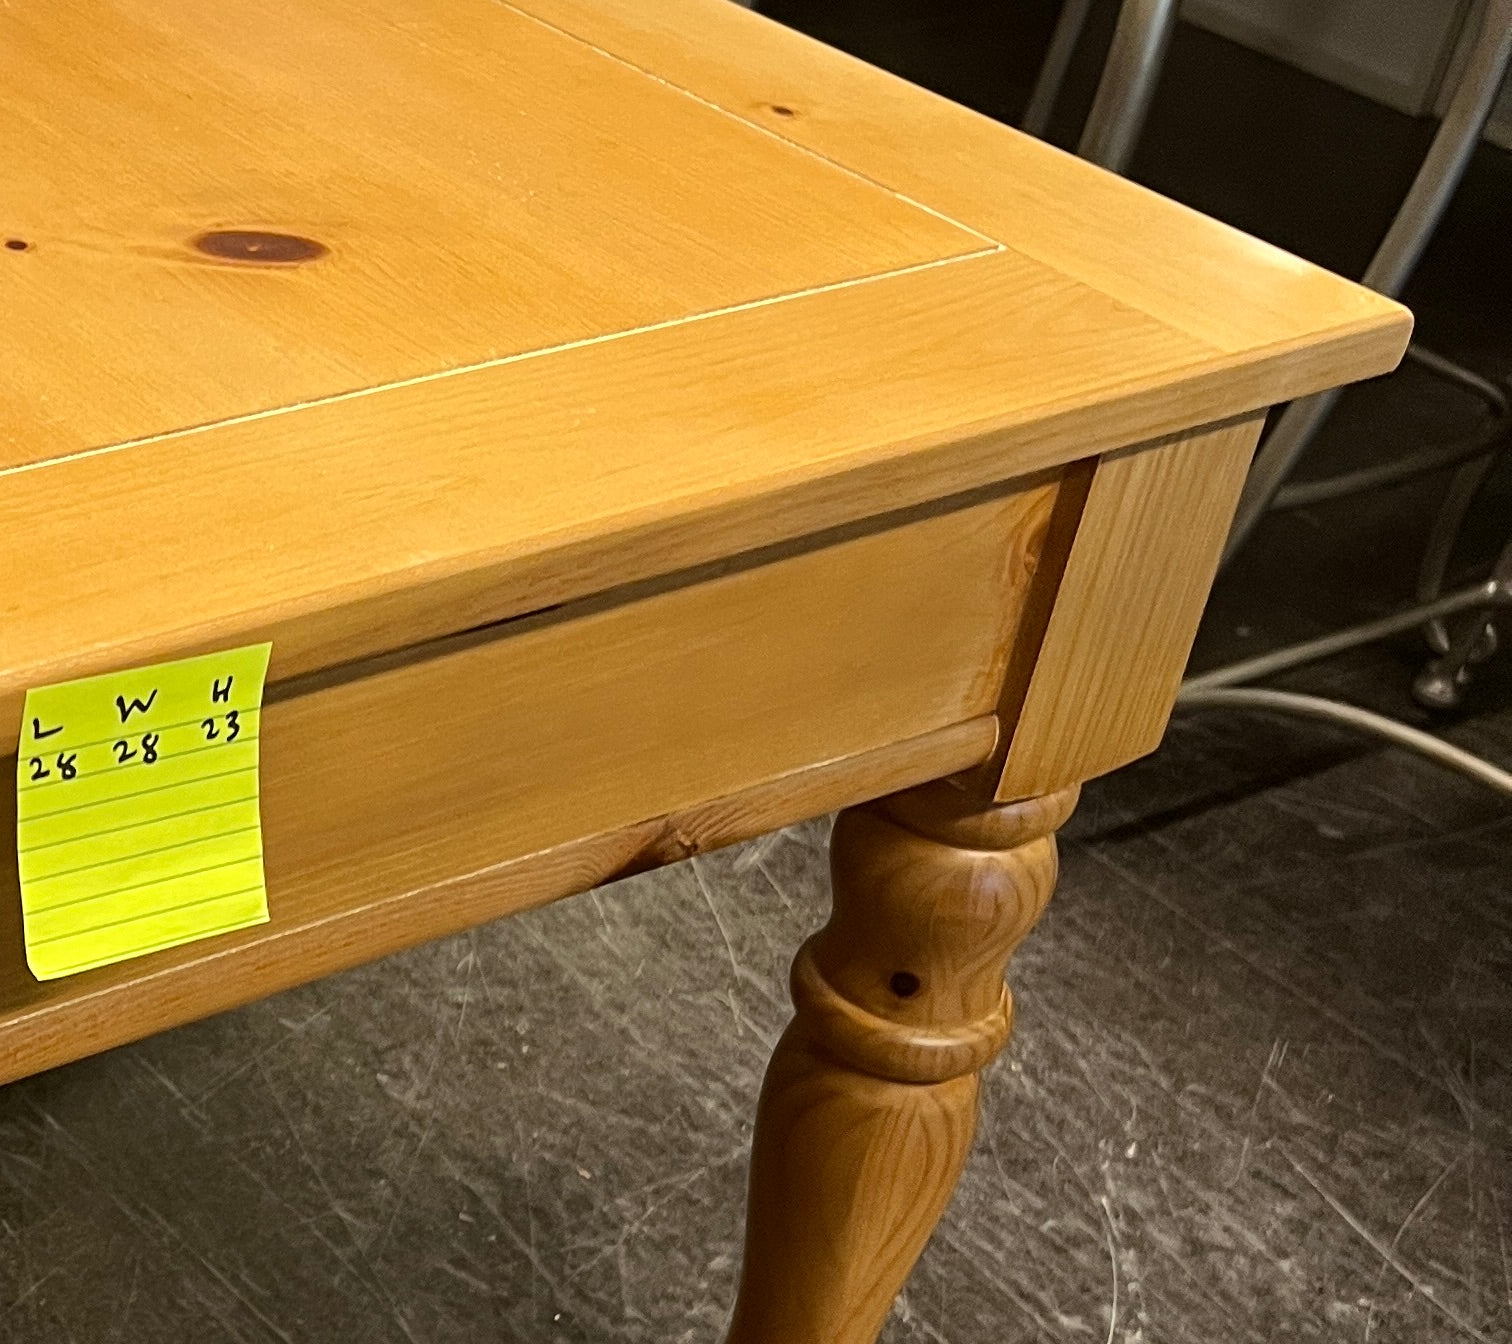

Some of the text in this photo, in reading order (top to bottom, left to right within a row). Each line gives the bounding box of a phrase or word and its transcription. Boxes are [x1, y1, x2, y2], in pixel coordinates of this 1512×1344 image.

[32, 675, 234, 740] L W H
[29, 709, 240, 781] 28 28 23
